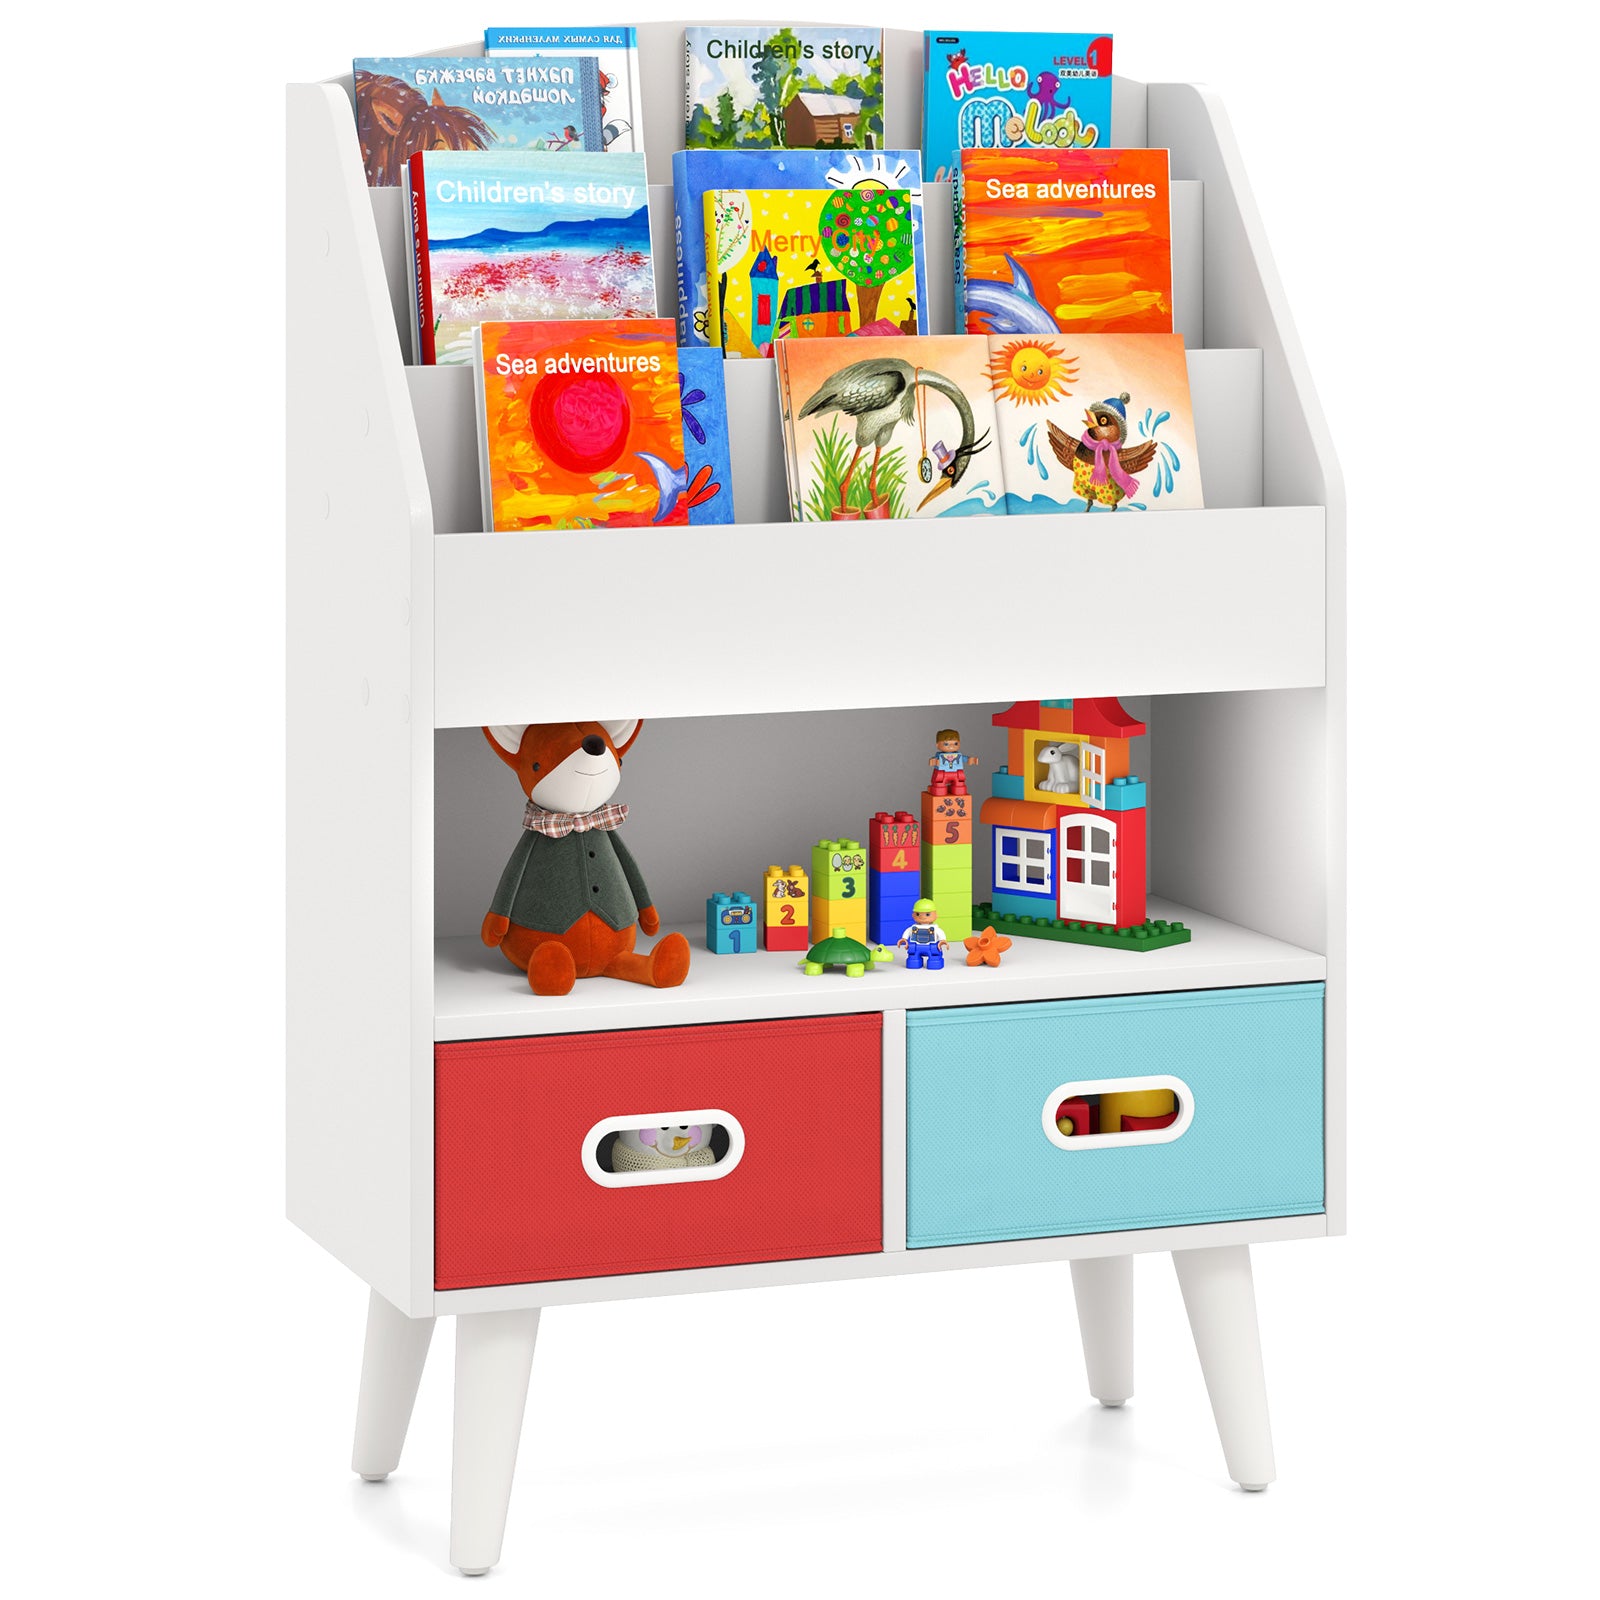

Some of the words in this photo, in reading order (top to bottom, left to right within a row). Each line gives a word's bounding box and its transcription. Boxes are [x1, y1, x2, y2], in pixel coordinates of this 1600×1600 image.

[706, 39, 814, 59] Children's
[822, 41, 874, 64] story
[1053, 56, 1087, 66] LEVEL
[1089, 49, 1098, 66] 1
[948, 65, 1026, 98] HELLO
[436, 180, 565, 204] Children's
[574, 182, 636, 209] story
[986, 178, 1029, 199] Sea
[1036, 179, 1157, 199] adventures
[750, 229, 823, 257] Merry
[831, 229, 881, 258] City
[495, 353, 538, 376] Sea
[544, 352, 661, 374] adventures
[945, 821, 960, 844] 5
[891, 849, 909, 870] 4
[841, 876, 857, 899] 3
[780, 904, 796, 925] 2
[728, 929, 741, 953] 1
